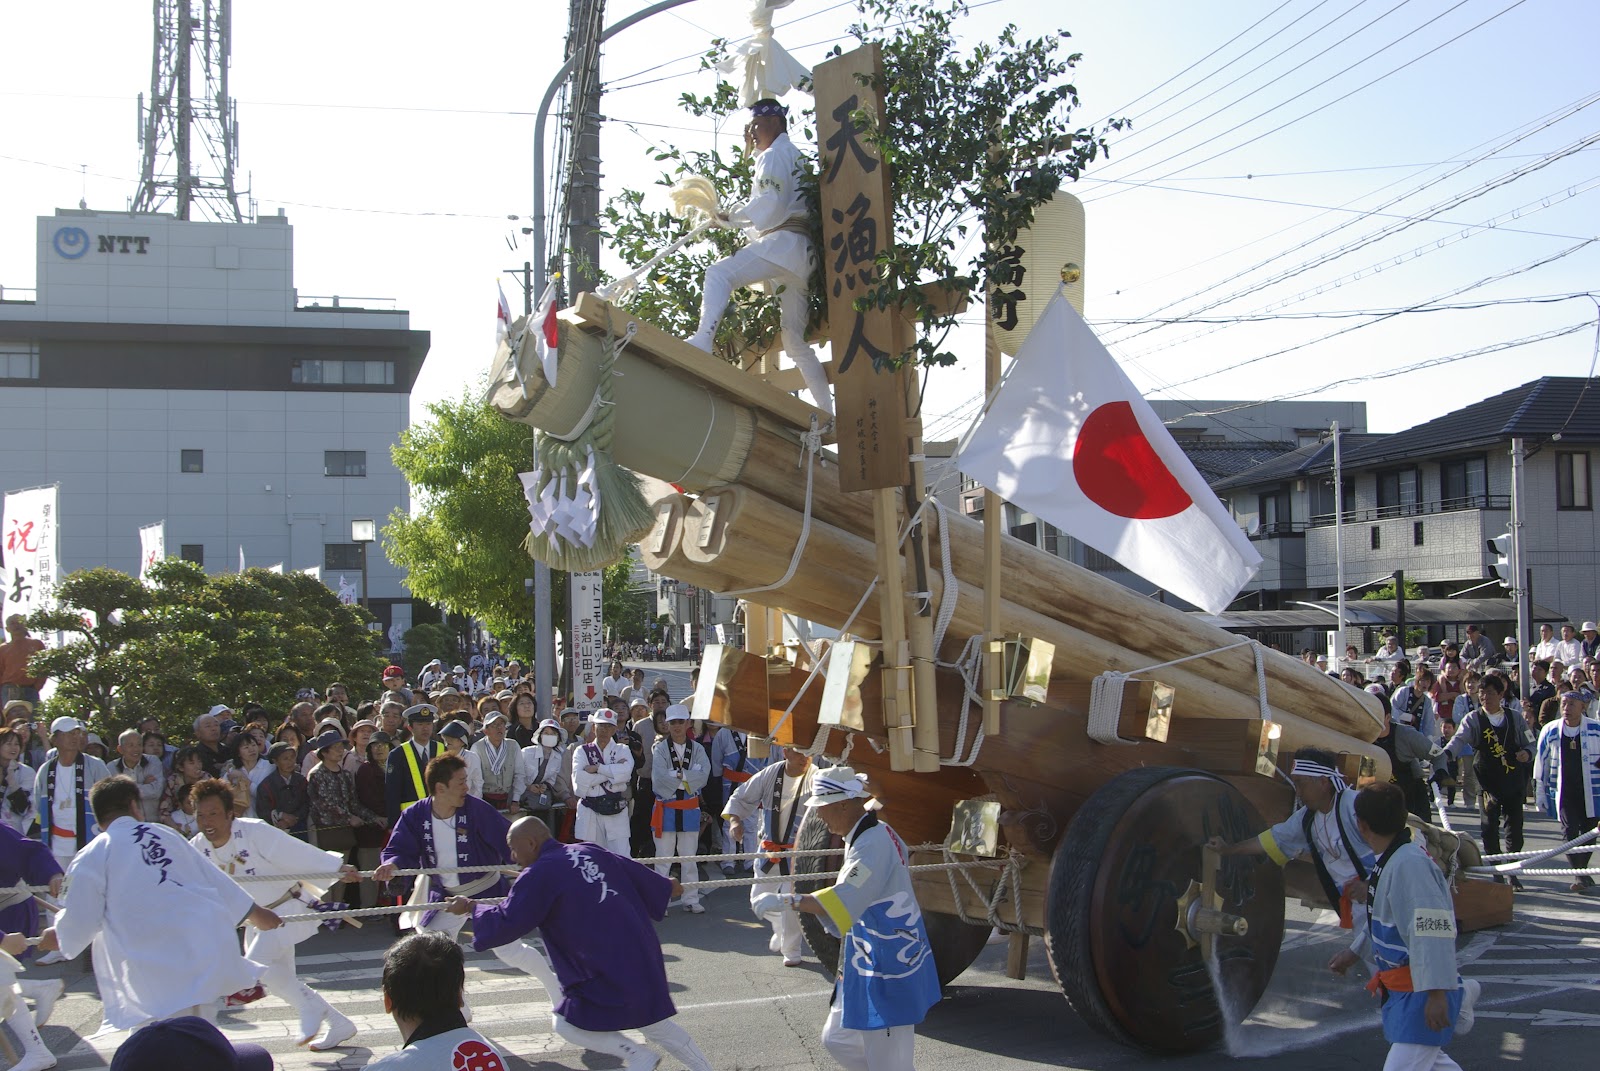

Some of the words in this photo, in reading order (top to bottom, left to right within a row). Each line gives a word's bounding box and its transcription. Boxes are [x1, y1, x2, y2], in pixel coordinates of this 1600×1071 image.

[98, 235, 150, 254] NTT
[826, 94, 890, 374] 天漁人
[581, 618, 593, 684] 宇治山田店
[592, 583, 602, 677] ドコモショップ
[577, 701, 602, 709] 26-1000
[130, 824, 183, 887] 天漁人
[457, 815, 469, 861] 川端町
[565, 848, 618, 903] 天漁人
[1415, 916, 1452, 932] 荷役係長
